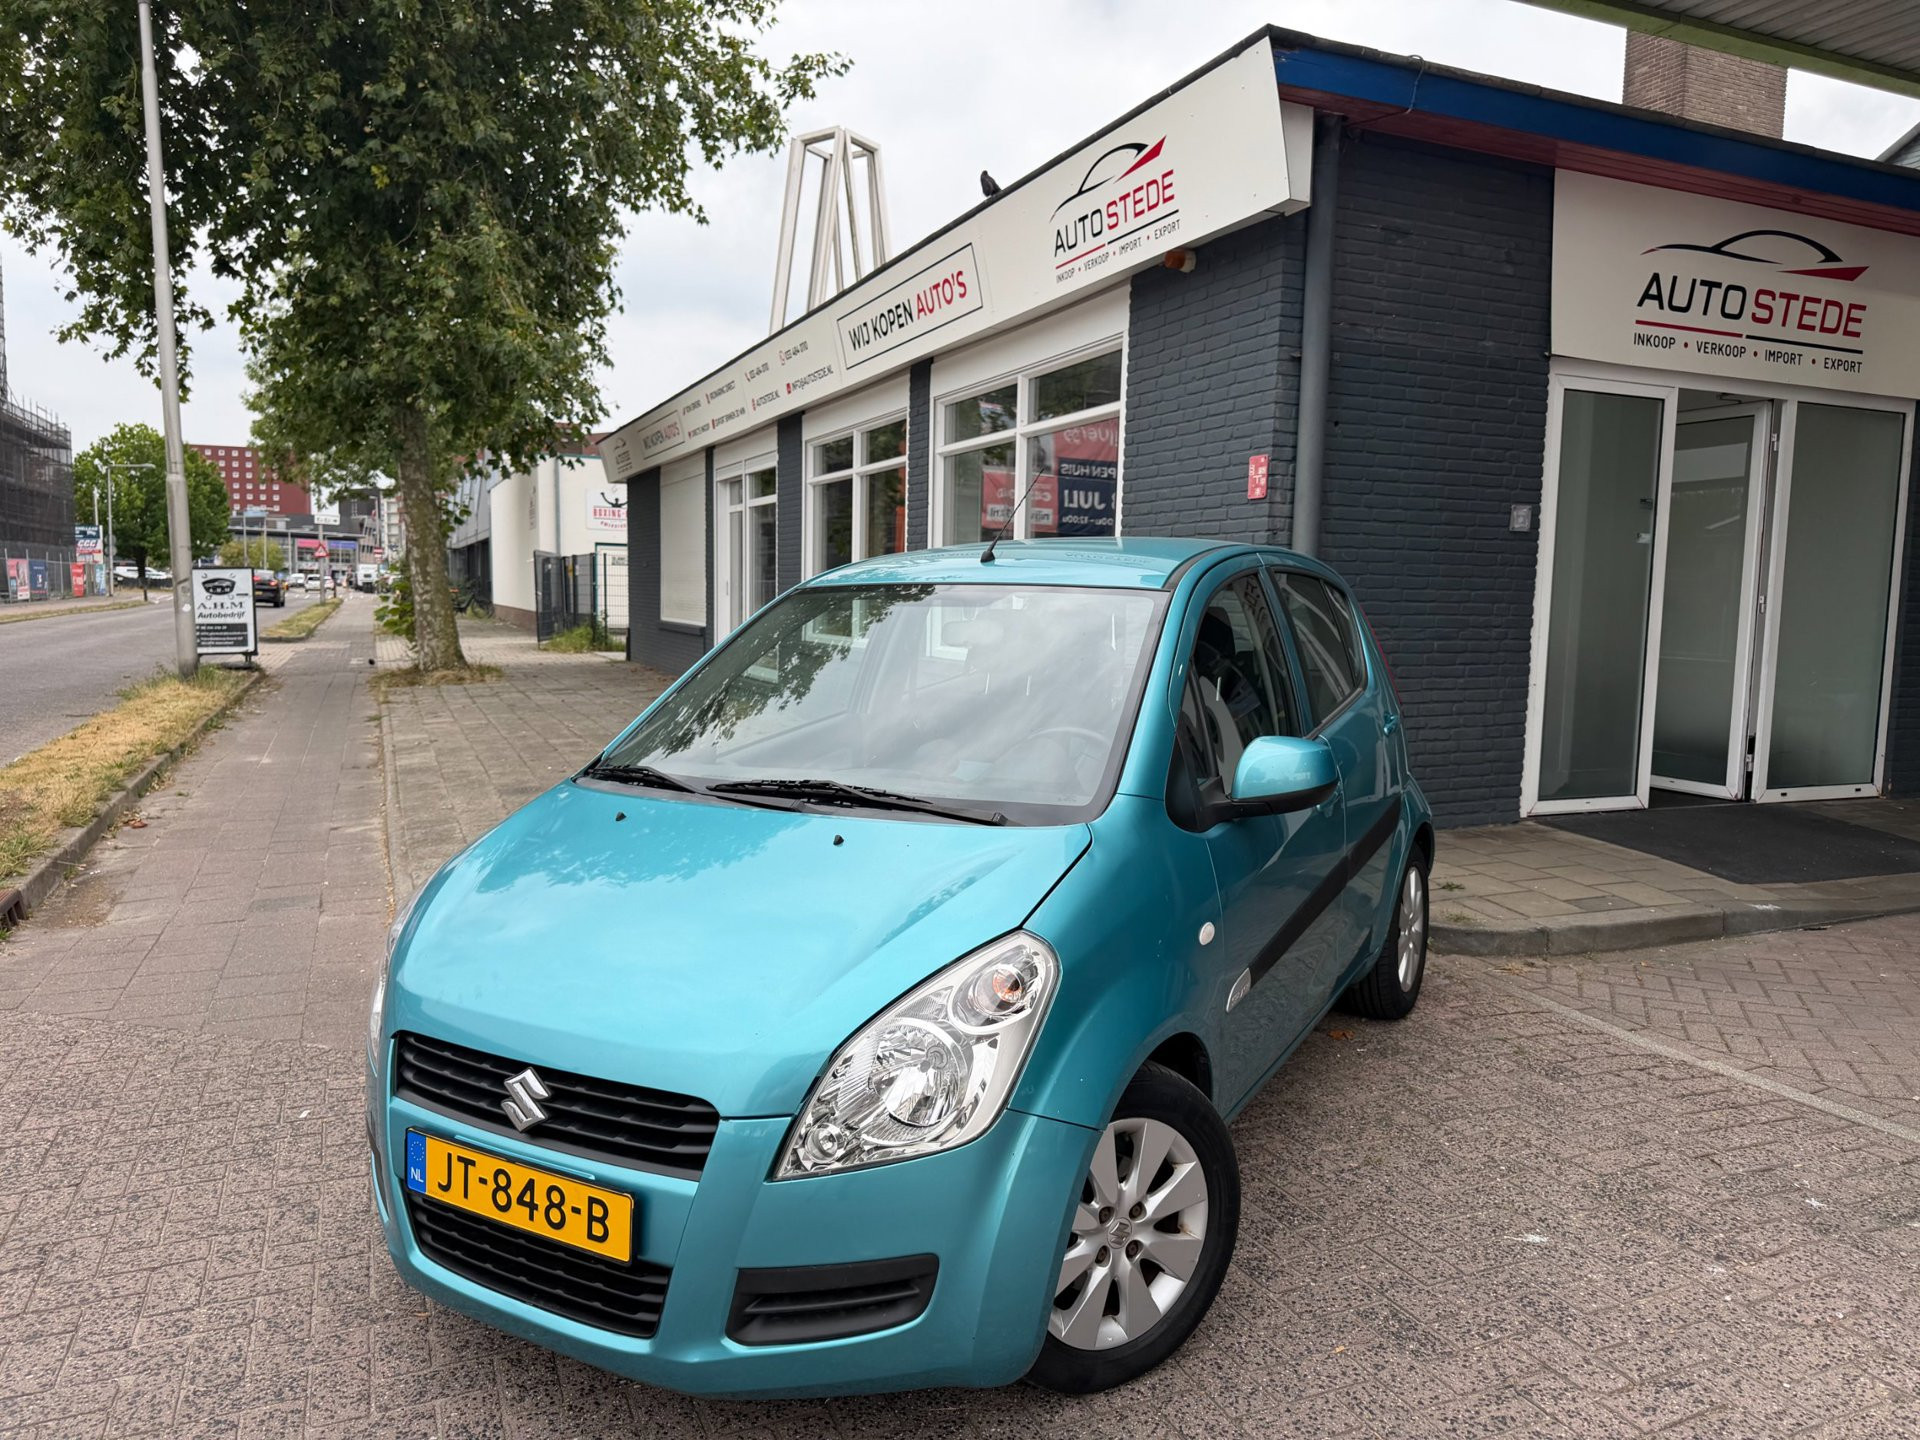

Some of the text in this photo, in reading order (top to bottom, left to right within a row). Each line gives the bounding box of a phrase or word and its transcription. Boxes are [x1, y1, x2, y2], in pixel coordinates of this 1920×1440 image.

[1056, 219, 1181, 284] INKOOP VERKOOP IMPORT EXPORT
[849, 320, 870, 351] WIJ
[871, 297, 914, 340] KOPEN
[916, 270, 967, 320] AUTO'S
[1633, 332, 1863, 374] INKOOP VERKOOP IMPORT EXPORT
[410, 1167, 424, 1183] NL
[438, 1152, 609, 1243] JT-848-B
